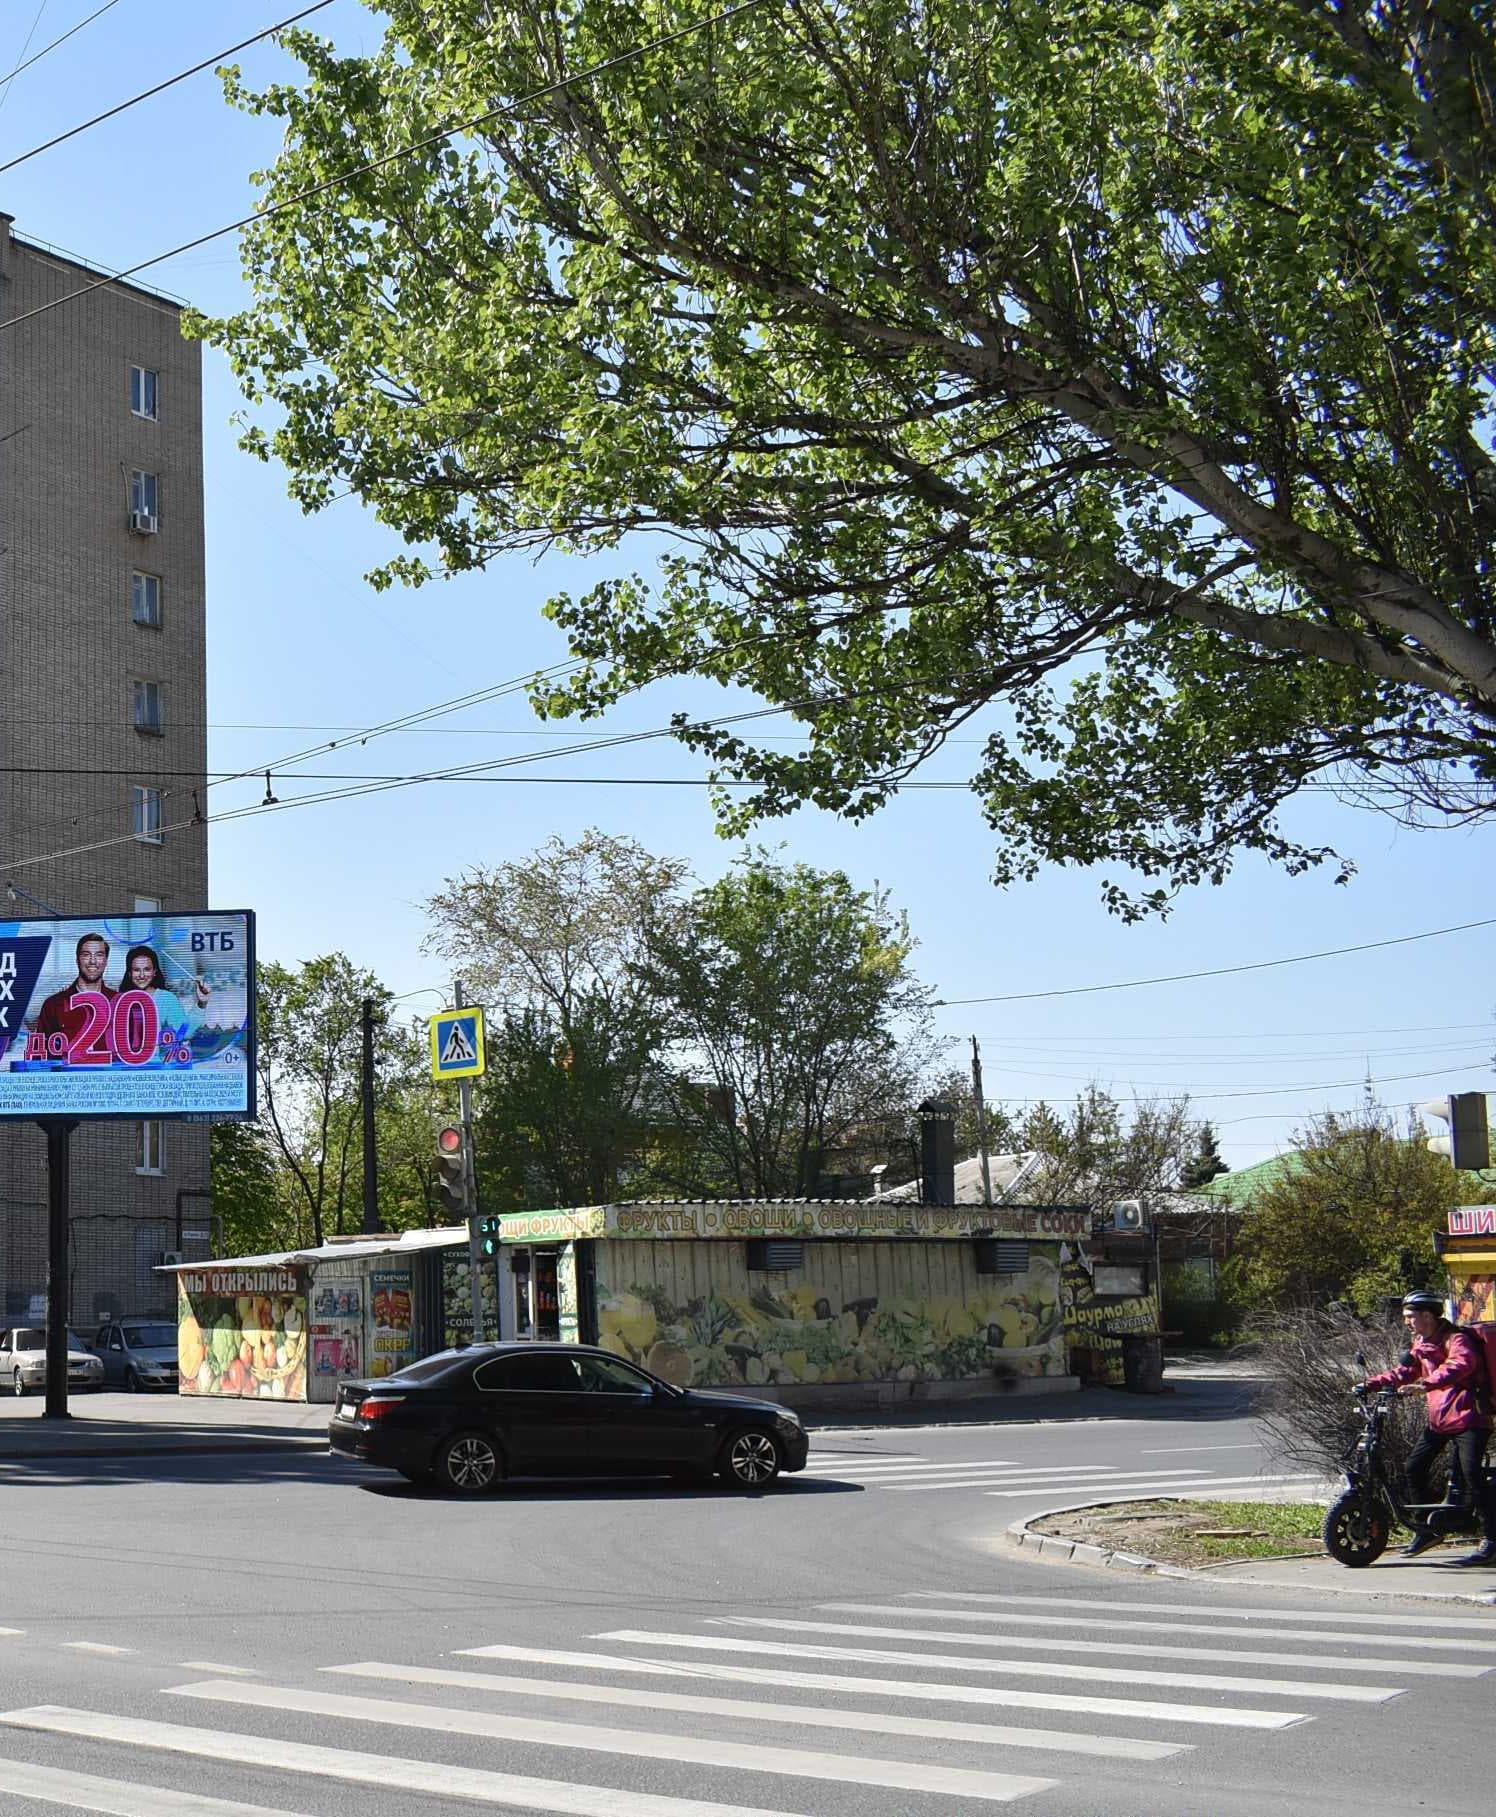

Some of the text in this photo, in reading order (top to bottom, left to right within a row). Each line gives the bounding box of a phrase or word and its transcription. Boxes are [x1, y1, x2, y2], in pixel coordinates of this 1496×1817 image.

[191, 931, 234, 951] ВТБ
[67, 990, 160, 1067] 20
[531, 1215, 589, 1234] ФРУКТЫ
[617, 1208, 1086, 1234] ФРУКТЫ ОВОЩИ ОВОЩНЫЕ И ФРУКТОВЫЕ СОКИ
[184, 1271, 297, 1293] МЫ ОТКРЫЛИСЬ
[449, 1317, 493, 1327] СОЛЕЬЯ
